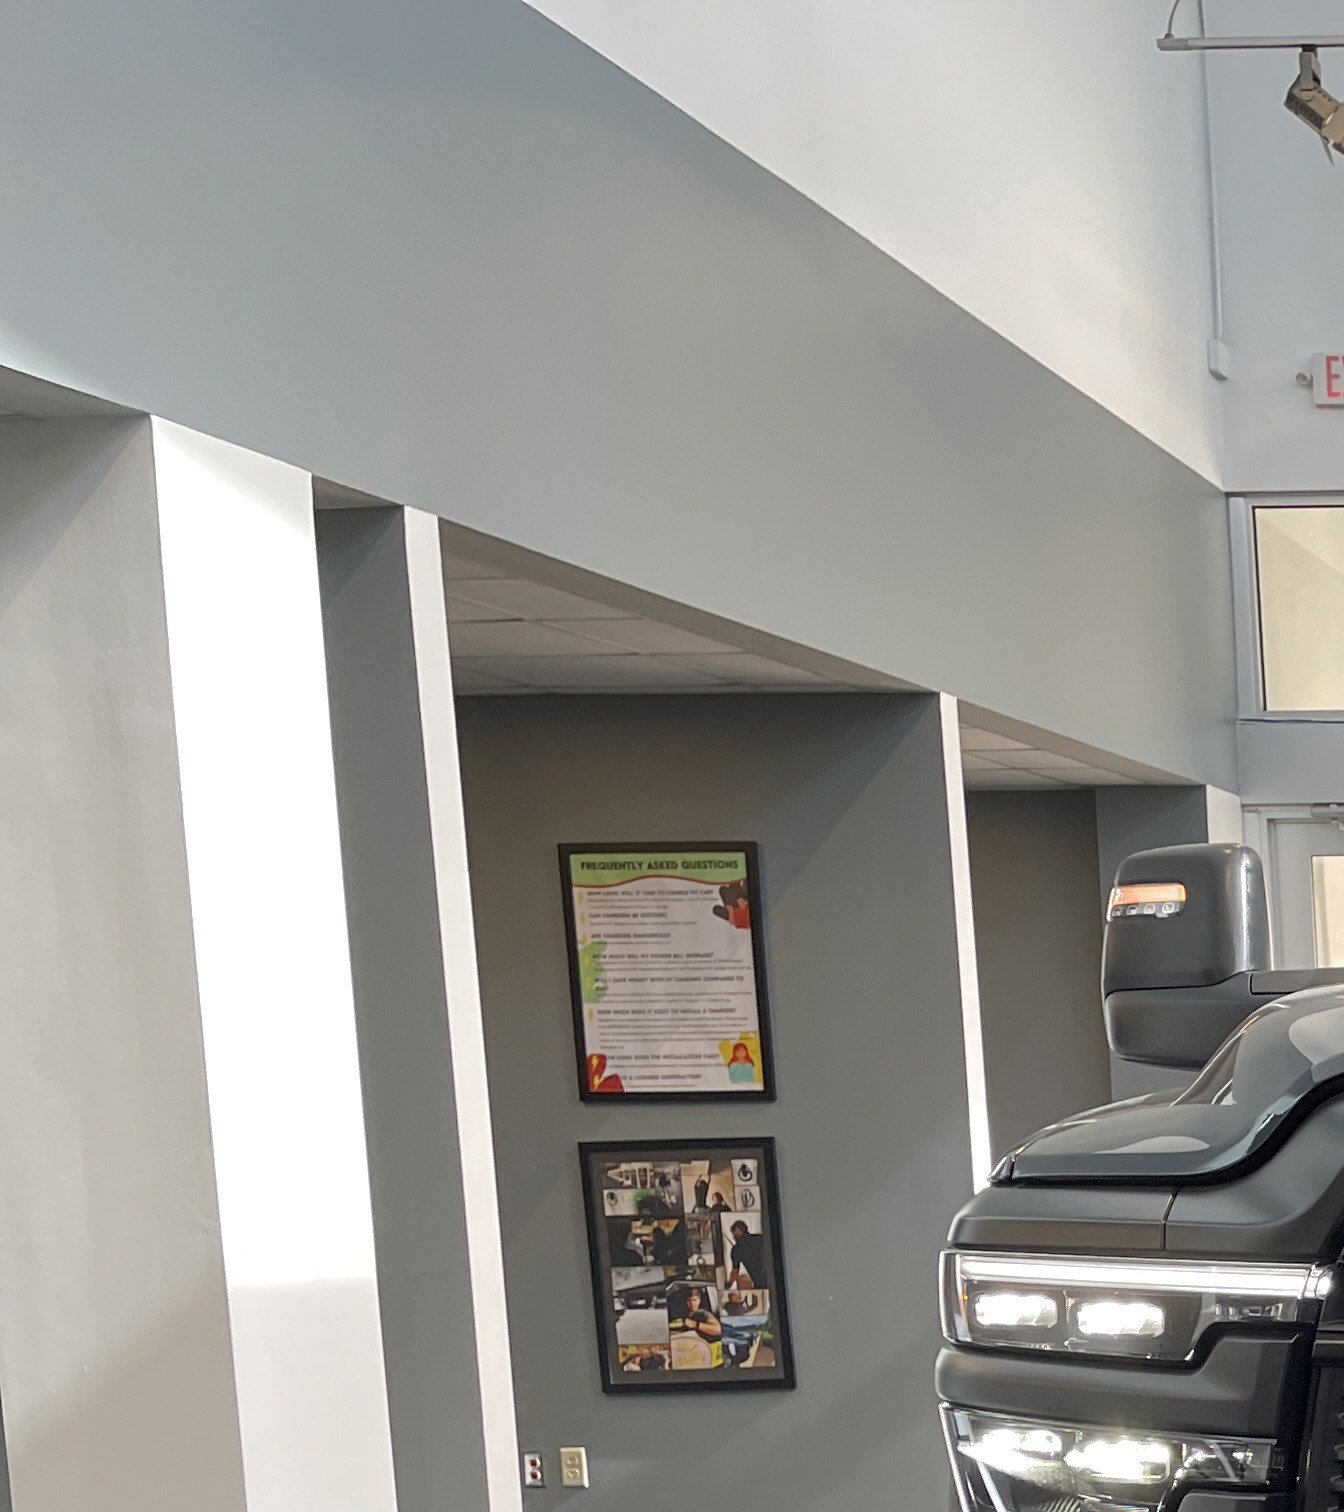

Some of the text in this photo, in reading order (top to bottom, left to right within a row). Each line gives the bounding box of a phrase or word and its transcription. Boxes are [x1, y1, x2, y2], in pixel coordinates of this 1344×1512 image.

[580, 859, 739, 871] FREQUENTLY ASKED QUESTIONS
